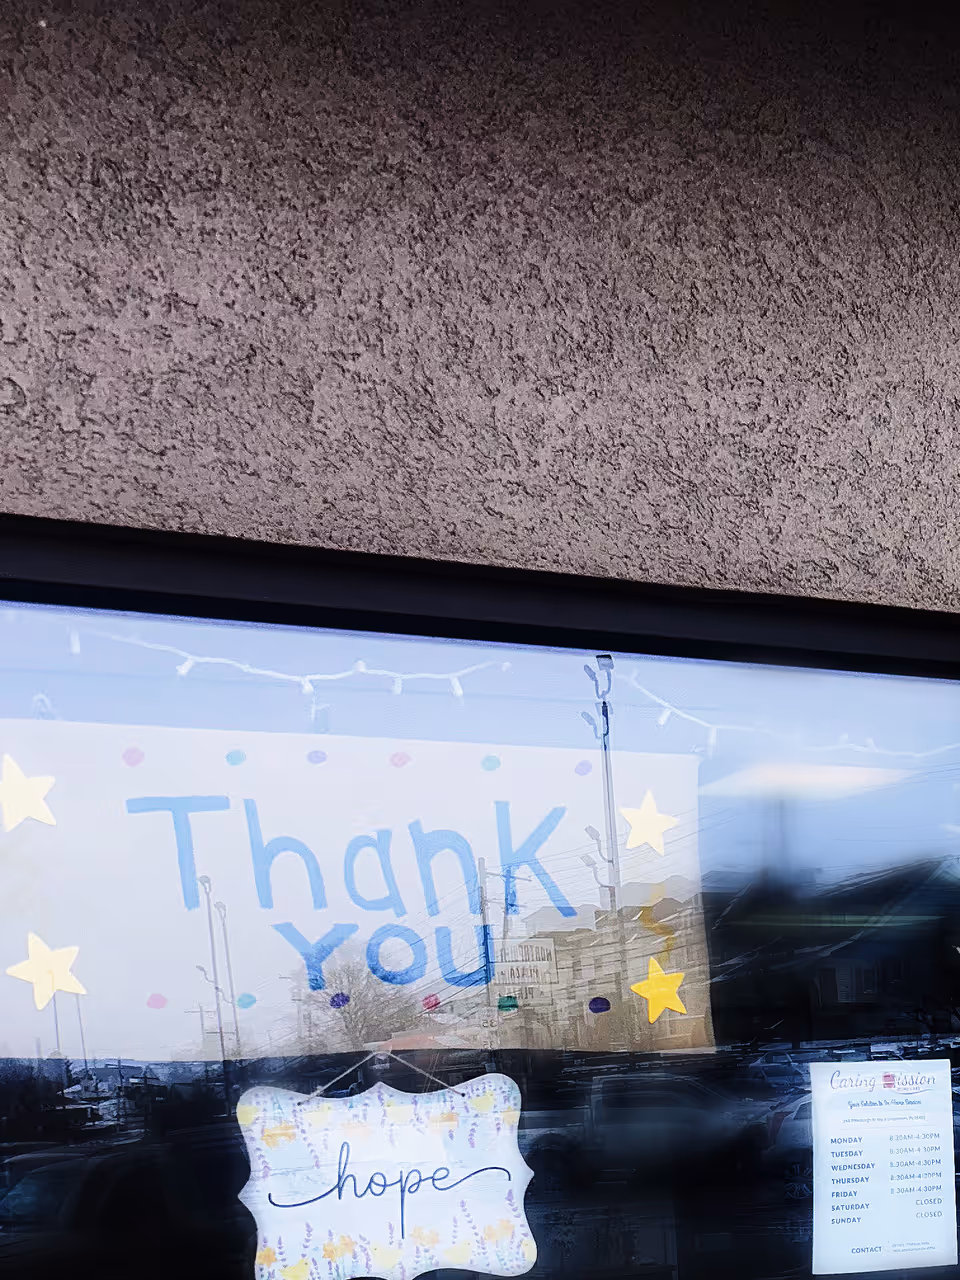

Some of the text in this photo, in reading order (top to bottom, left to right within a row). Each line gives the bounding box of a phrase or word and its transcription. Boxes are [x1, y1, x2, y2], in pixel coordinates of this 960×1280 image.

[830, 1070, 936, 1092] Caring ission
[830, 1136, 863, 1145] MONDAY
[830, 1150, 864, 1158] TUESDAY
[831, 1163, 876, 1172] WEDNESDAY
[831, 1176, 870, 1185] THURSDAY
[267, 1140, 512, 1240] hope
[831, 1190, 858, 1198] FRIDAY
[831, 1197, 943, 1212] SATURDAY CLOSED
[831, 1211, 943, 1225] SUNDAY CLOSED
[851, 1246, 882, 1254] CONTACT
